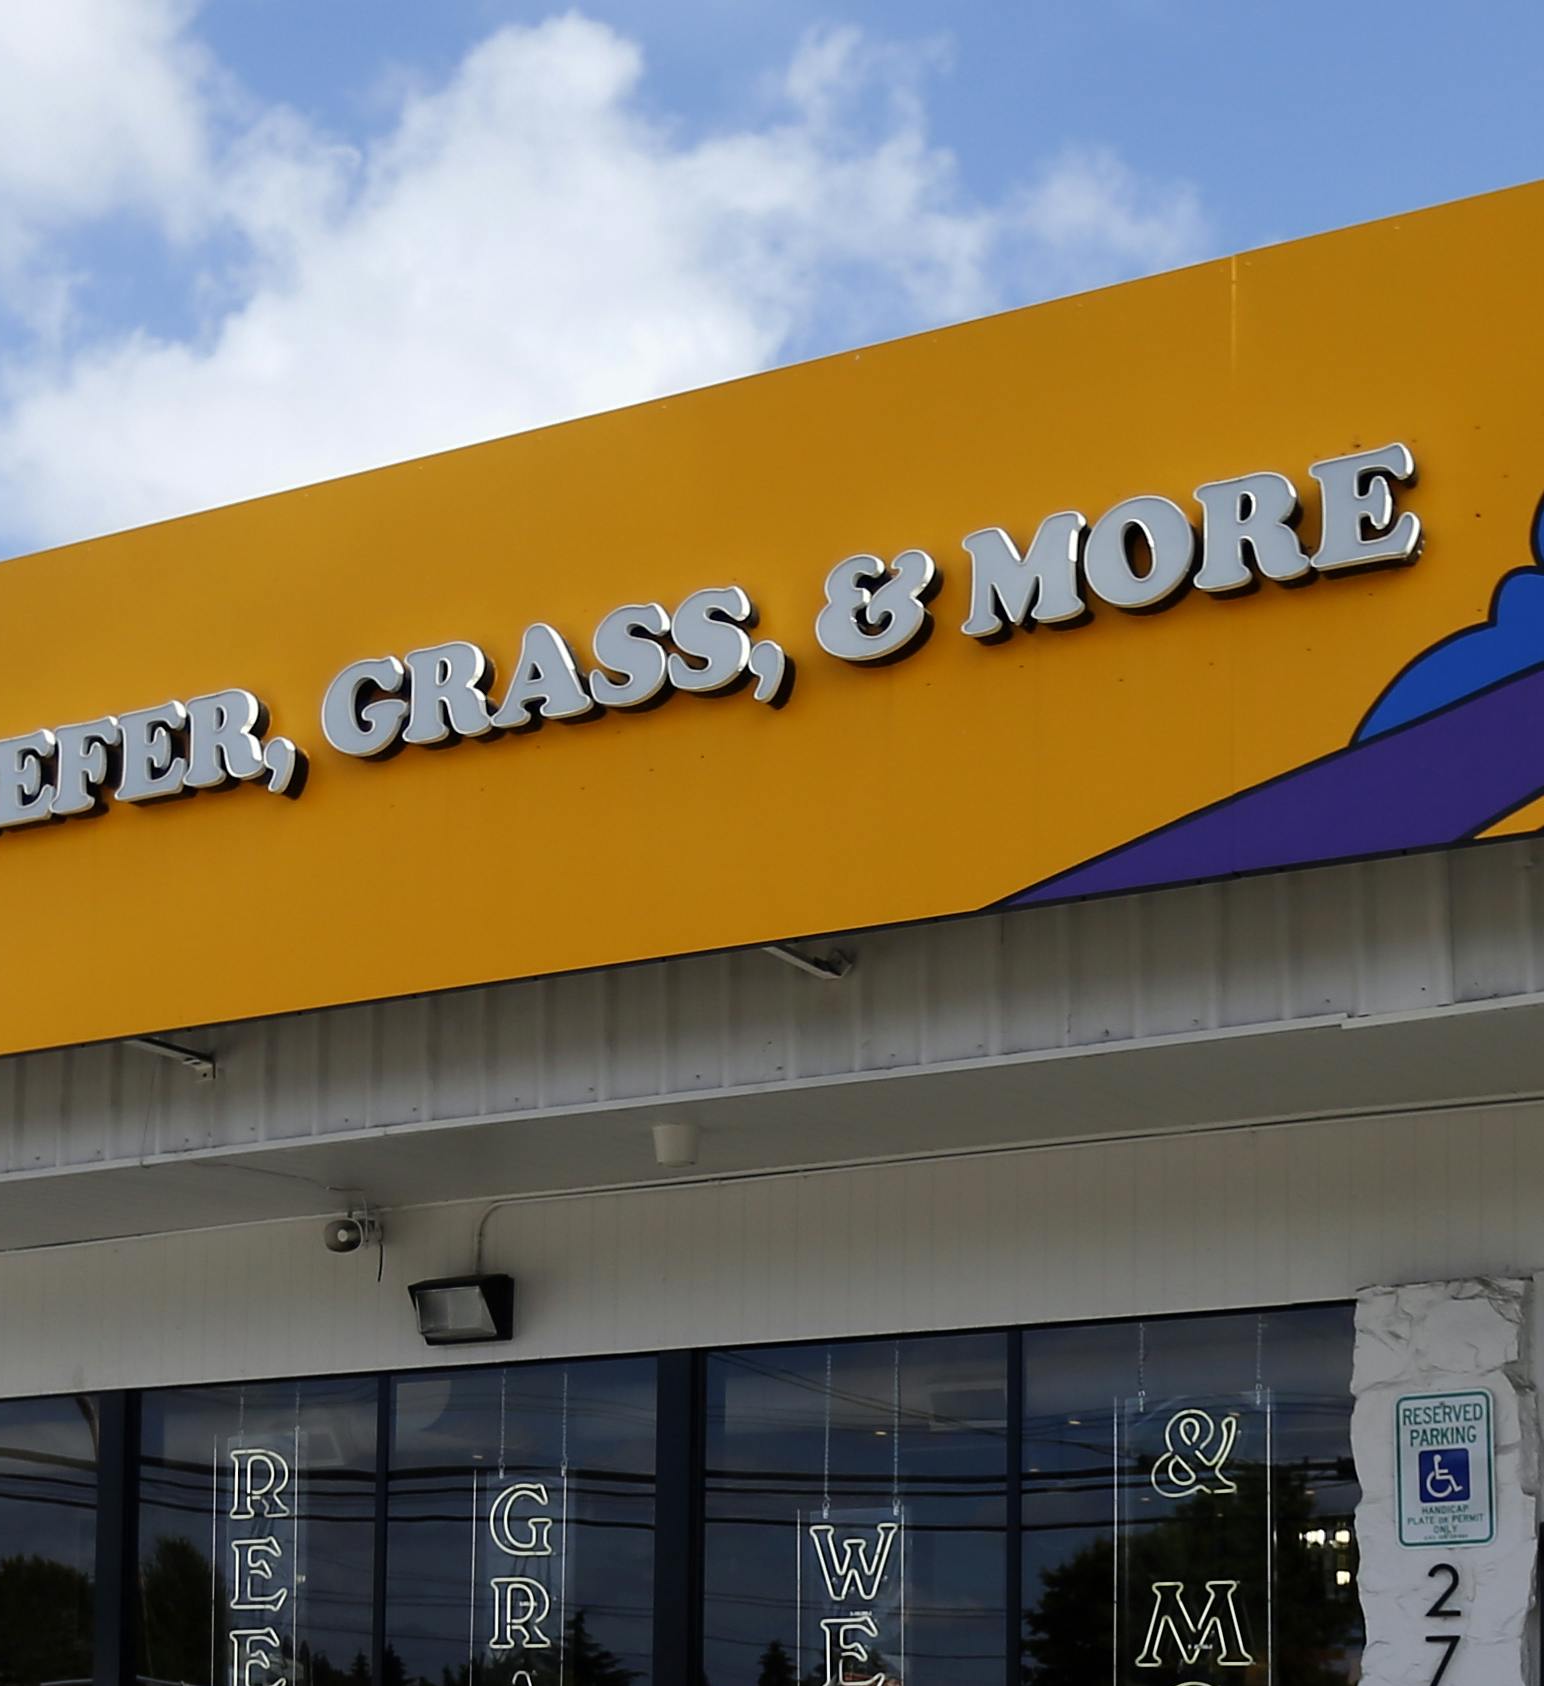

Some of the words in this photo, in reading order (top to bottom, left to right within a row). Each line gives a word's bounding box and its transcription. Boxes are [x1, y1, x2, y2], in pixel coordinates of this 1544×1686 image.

[320, 584, 788, 757] GRASS,
[813, 548, 936, 664] &
[961, 442, 1422, 637] MORE
[1402, 1403, 1484, 1426] RESERVED
[1410, 1425, 1477, 1447] PARKING
[1151, 1407, 1242, 1499] &
[1407, 1516, 1434, 1525] PLATE
[1452, 1513, 1483, 1523] PERMIT
[1422, 1505, 1468, 1514] HANDICAP
[1433, 1525, 1457, 1533] ONLY
